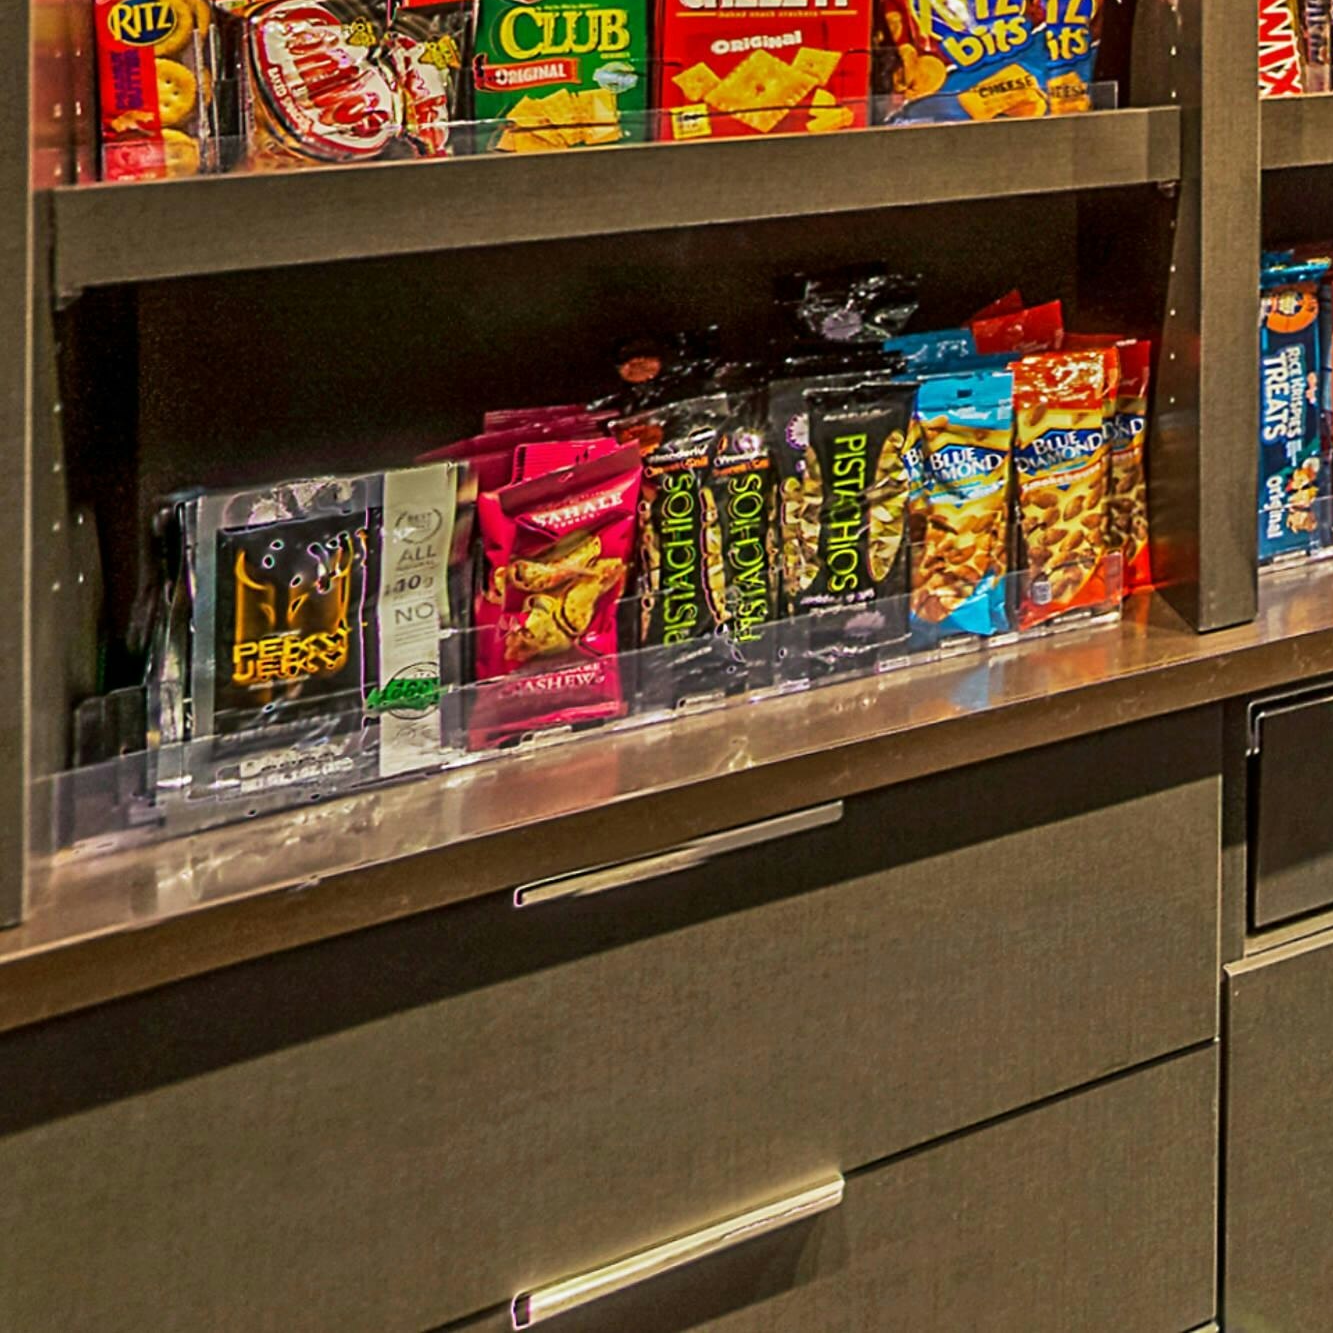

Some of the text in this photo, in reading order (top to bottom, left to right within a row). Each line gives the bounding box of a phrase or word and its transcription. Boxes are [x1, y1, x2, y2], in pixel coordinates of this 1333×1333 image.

[111, 1, 172, 41] RITZ
[499, 6, 631, 61] CLUB
[942, 16, 1030, 66] bits
[1046, 26, 1089, 61] its
[495, 62, 568, 86] ORIGINAL
[978, 74, 1035, 98] CHEESE
[1262, 352, 1288, 442] TREATS
[1286, 376, 1307, 439] KRISPIES
[930, 446, 975, 471] BLUE
[1016, 433, 1104, 473] DIAMOND
[1033, 431, 1078, 456] BLUE
[531, 492, 624, 528] SAHALE
[825, 432, 869, 593] PISTACHIOS
[399, 545, 437, 564] ALL
[662, 472, 698, 648] PISTACHIOS
[394, 602, 435, 624] NO
